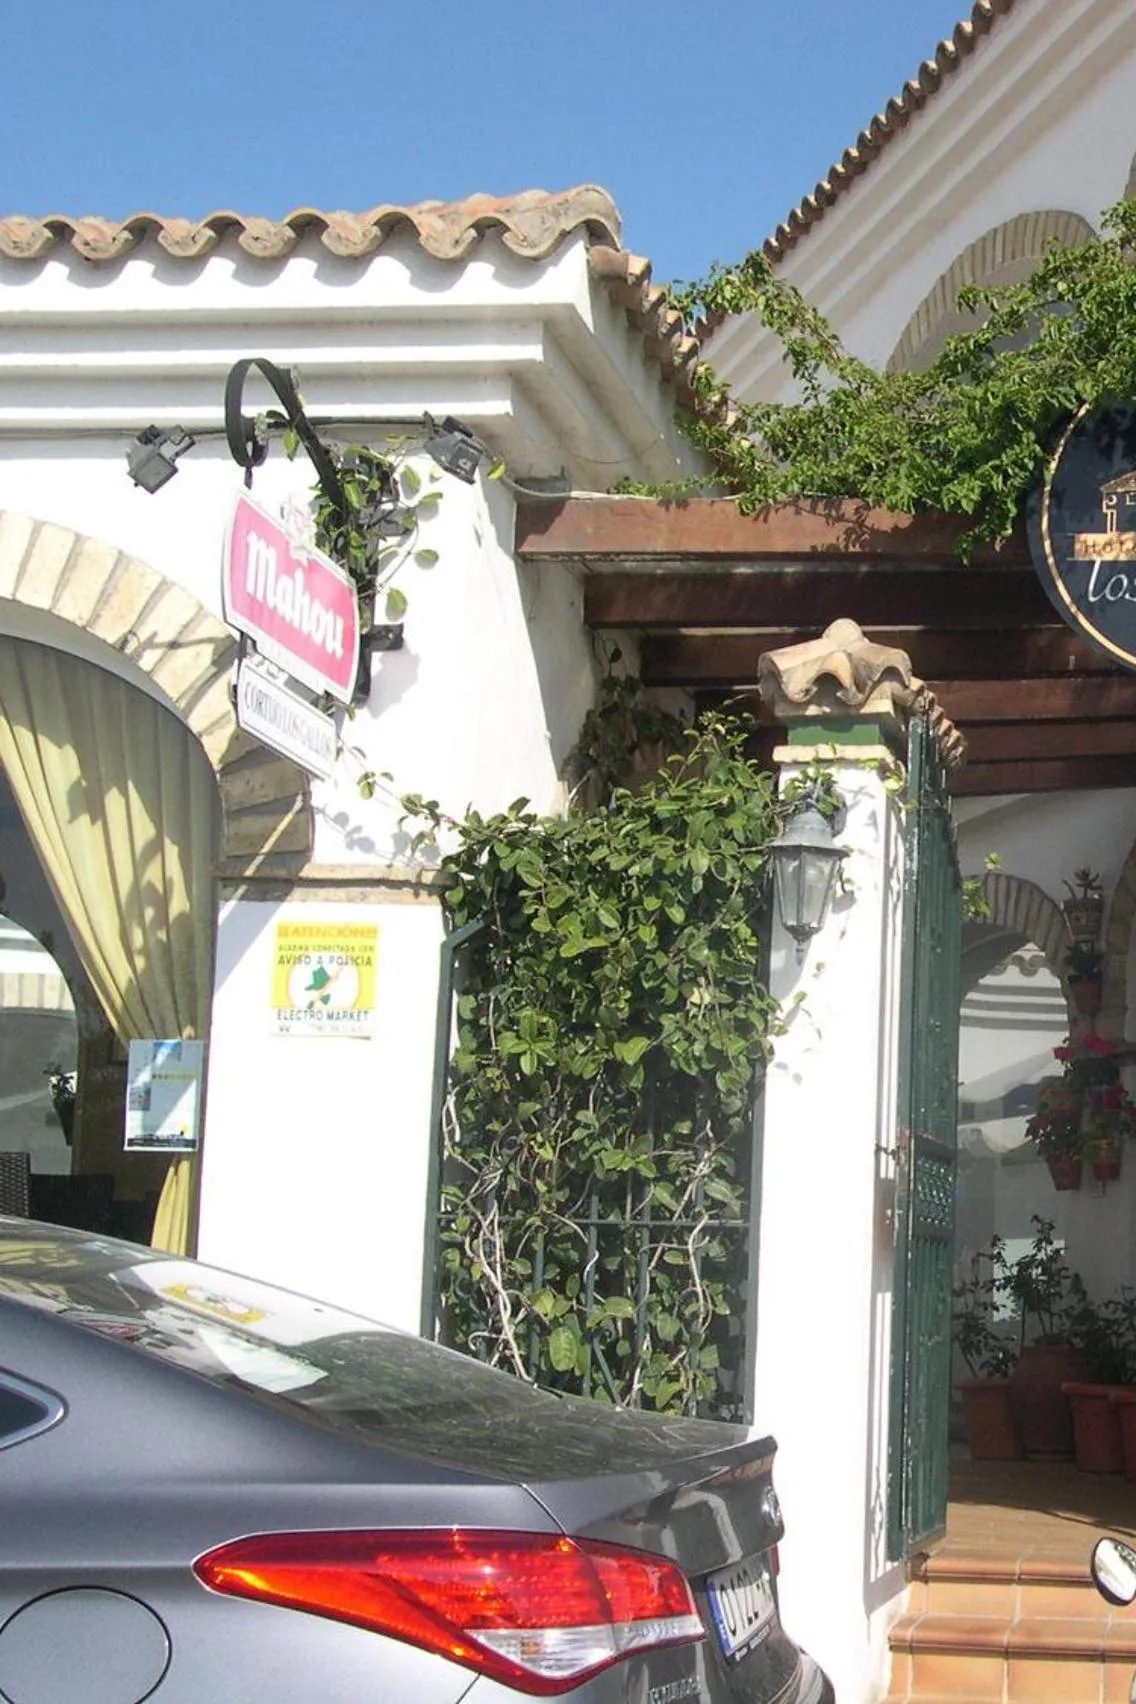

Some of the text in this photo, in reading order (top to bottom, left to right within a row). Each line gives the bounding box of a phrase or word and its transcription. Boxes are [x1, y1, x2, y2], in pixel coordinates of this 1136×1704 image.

[246, 530, 344, 660] Mahou
[278, 954, 311, 966] AVISO
[277, 1008, 369, 1021] ELECTRO MARKET
